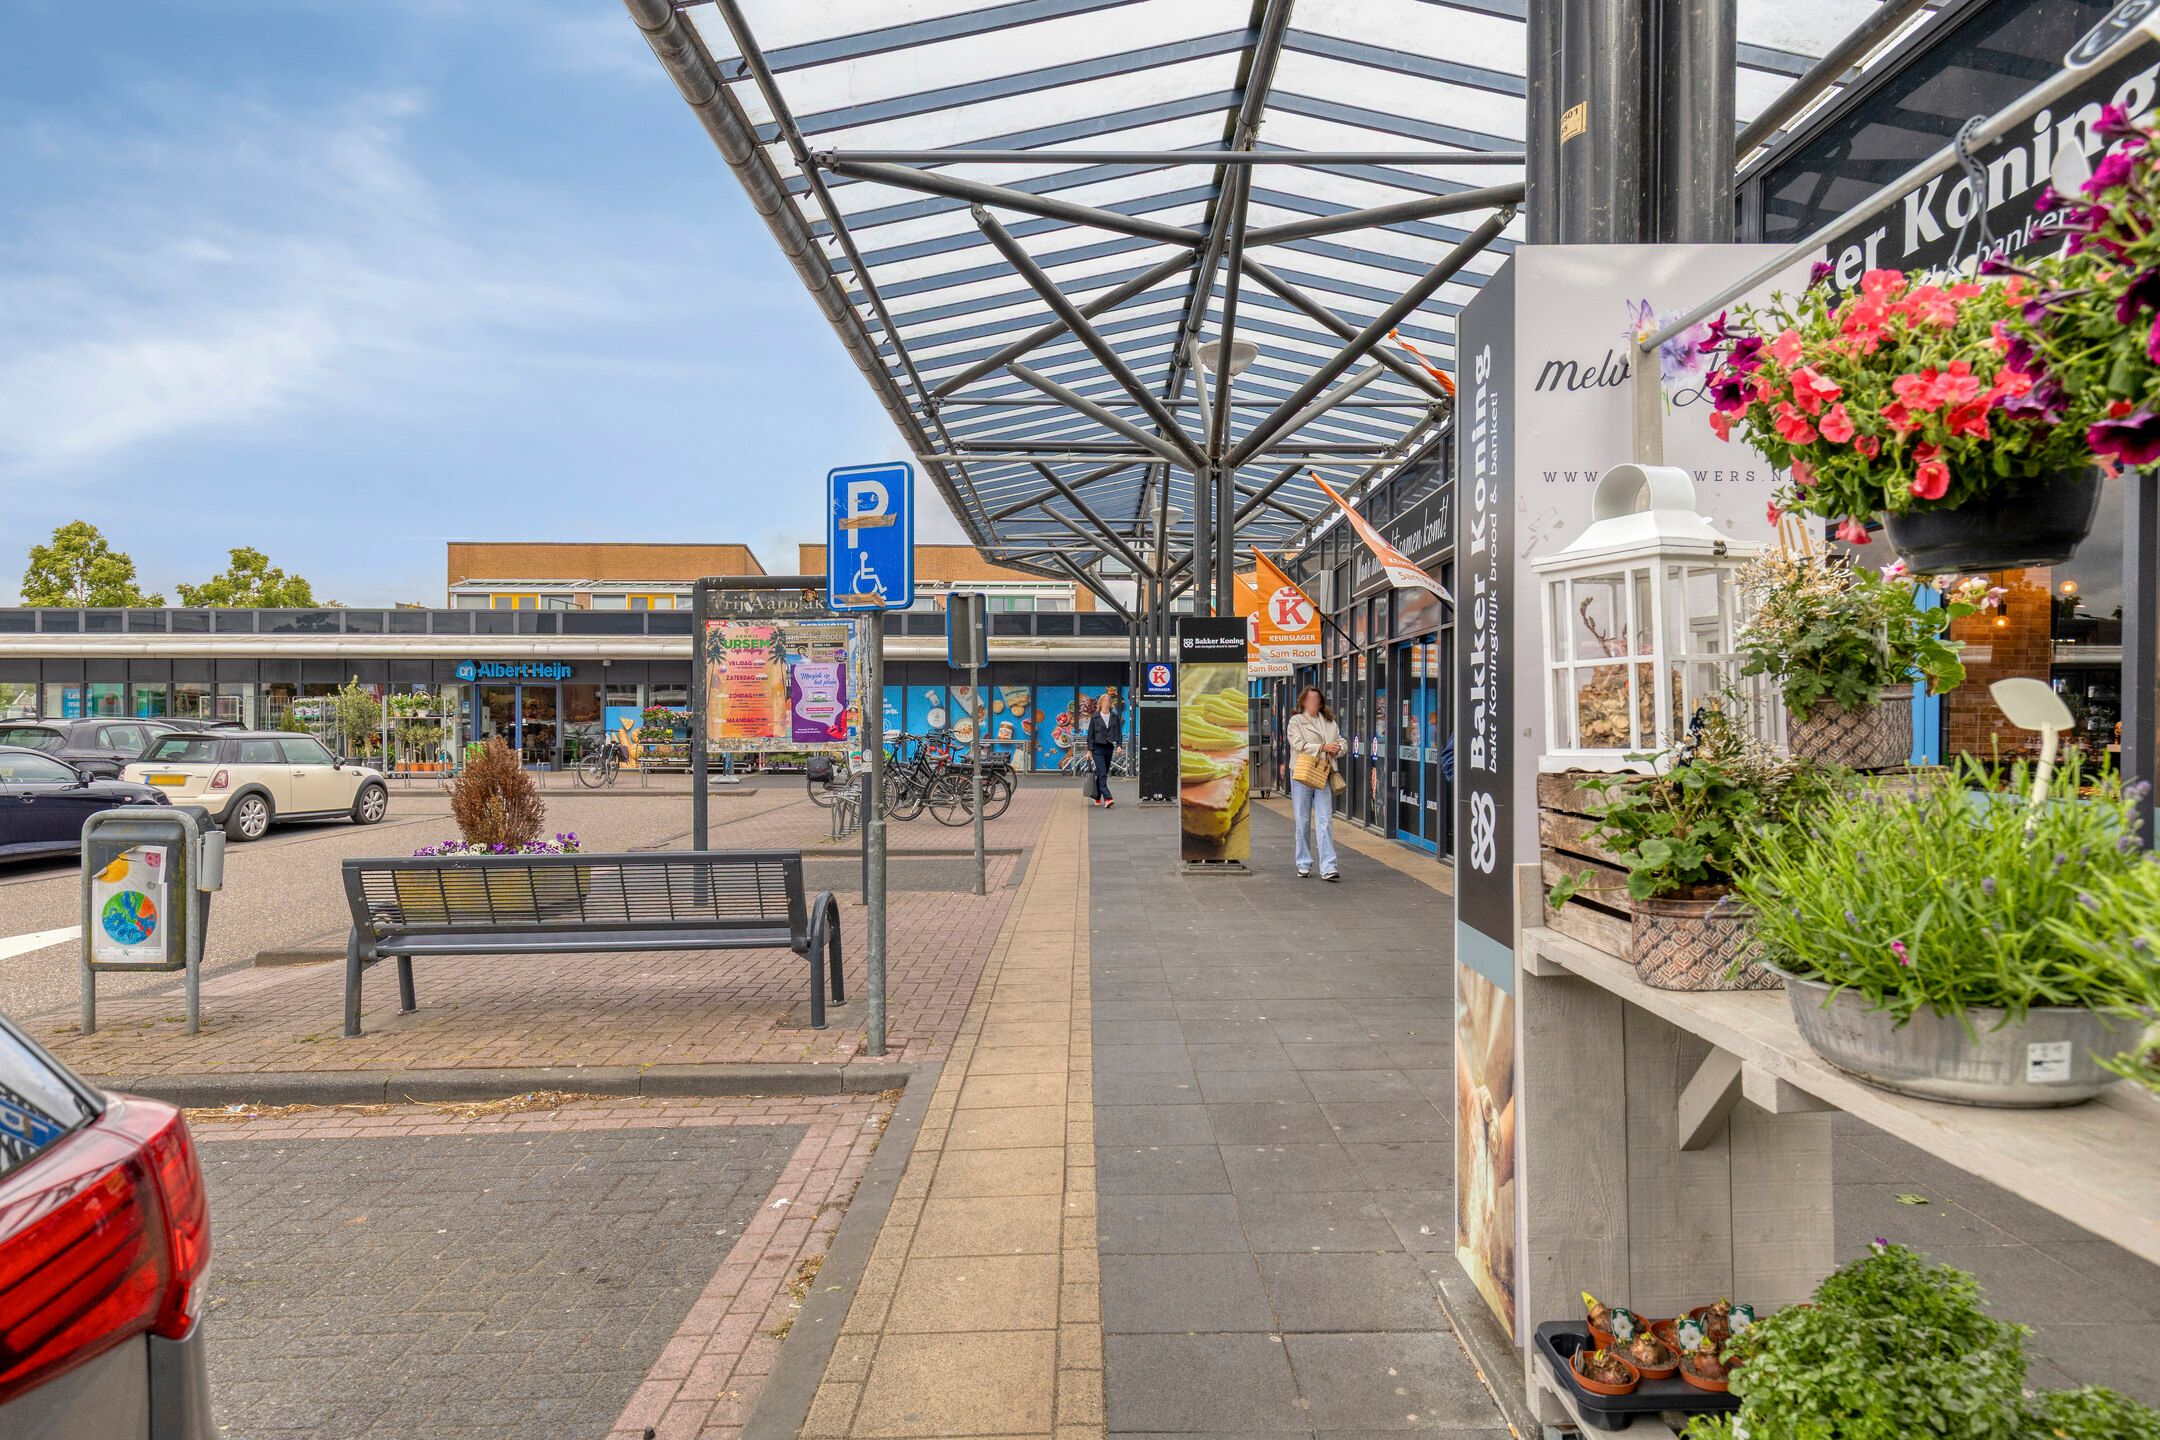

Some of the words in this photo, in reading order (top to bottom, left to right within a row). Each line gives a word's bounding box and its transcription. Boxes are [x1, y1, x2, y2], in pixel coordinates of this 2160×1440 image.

[1489, 391, 1498, 476] banket!
[1470, 344, 1491, 557] Koning
[1489, 482, 1497, 504] &
[847, 480, 889, 549] P
[1489, 513, 1497, 581] brood
[1275, 598, 1307, 625] K
[723, 639, 771, 649] URSEM
[1219, 637, 1244, 645] Koning
[1269, 634, 1316, 642] KEURSLAGER
[1269, 649, 1290, 658] Sam
[1292, 648, 1317, 657] Rood
[1489, 589, 1499, 717] Koningklijk
[478, 660, 529, 677] Albert
[531, 661, 572, 681] Heijn
[1152, 671, 1167, 684] K
[1248, 665, 1266, 673] Sam
[1267, 664, 1289, 672] Rood
[1470, 573, 1486, 771] Bakker
[1489, 722, 1497, 774] bakt
